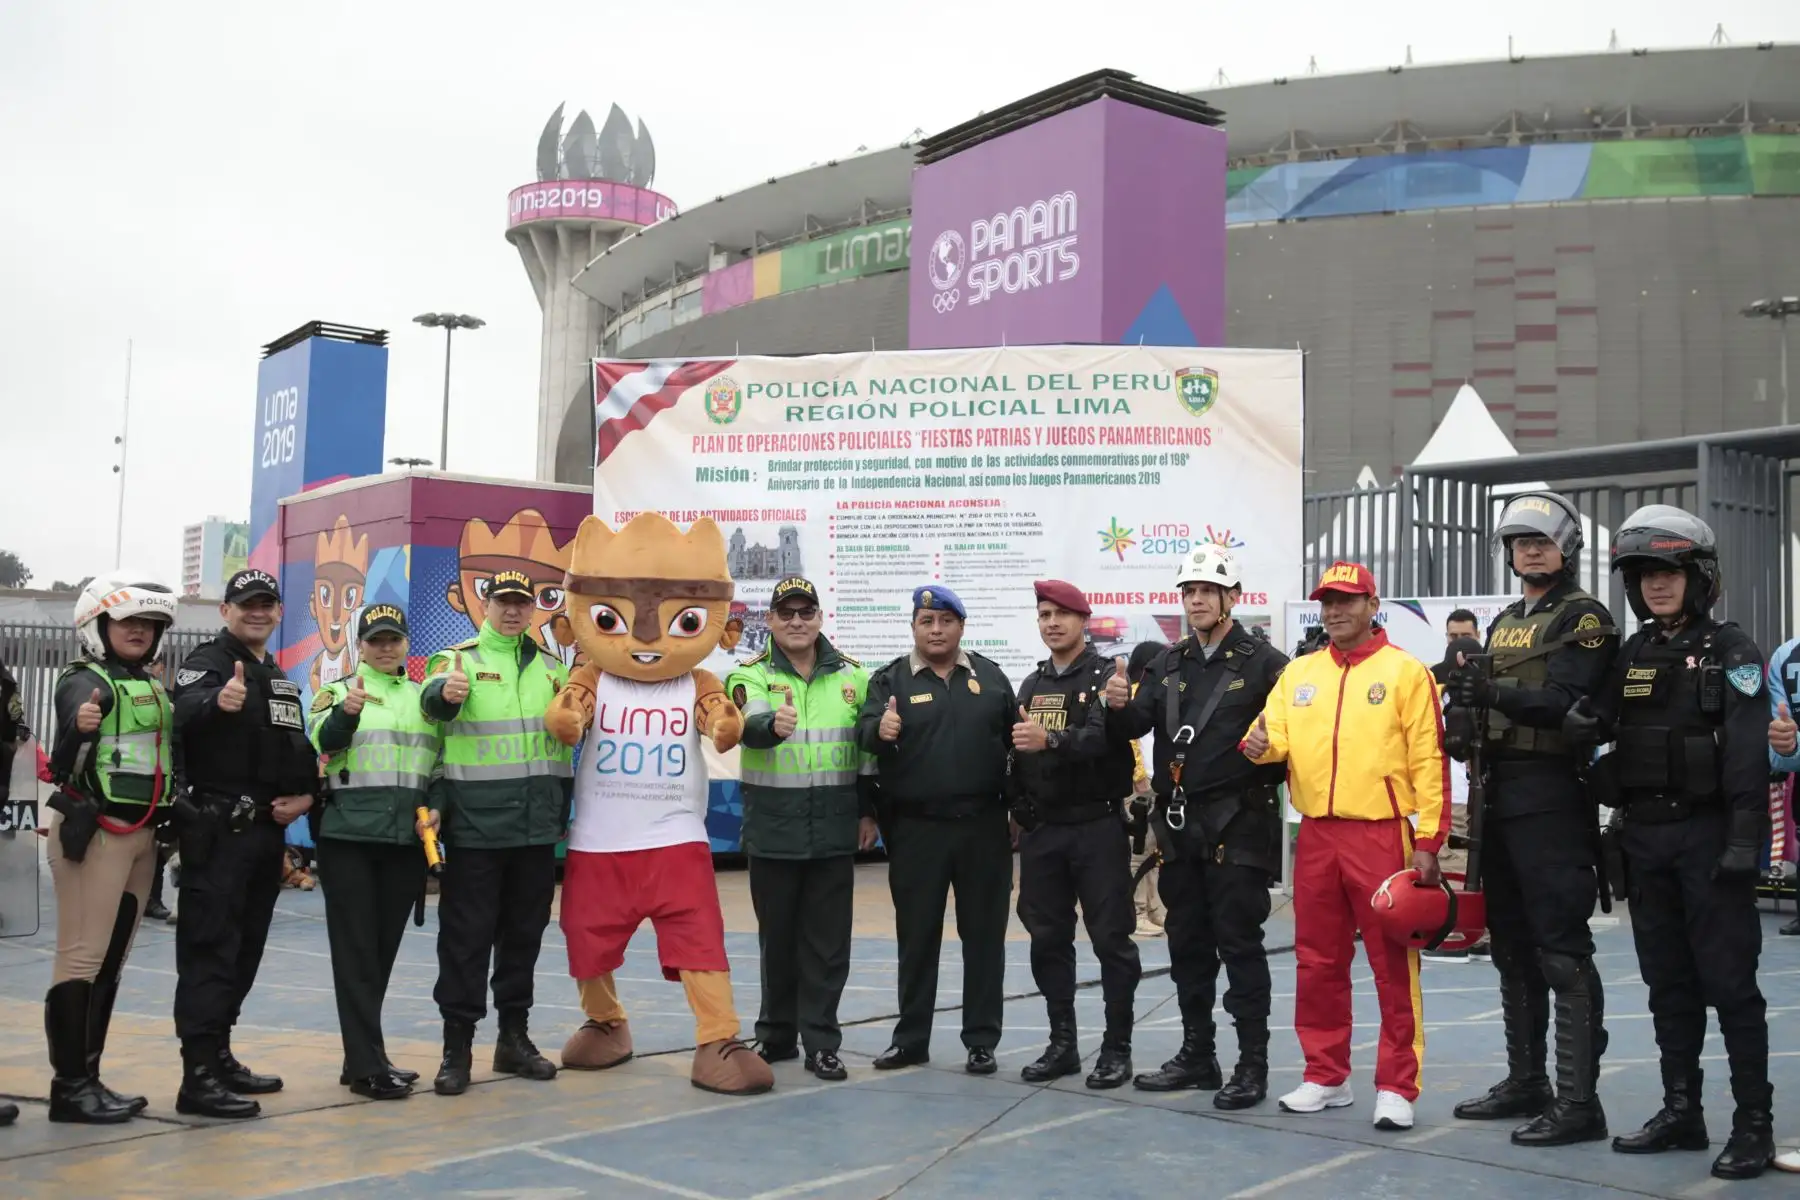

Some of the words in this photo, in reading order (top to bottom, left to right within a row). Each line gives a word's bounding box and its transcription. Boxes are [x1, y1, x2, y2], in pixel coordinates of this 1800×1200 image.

[971, 190, 1078, 261] PANAM
[967, 235, 1080, 306] SPORTS
[747, 375, 858, 399] POLICÍA
[869, 375, 1016, 396] NACIONAL
[1027, 374, 1082, 391] DEL
[1093, 369, 1171, 391] PERÚ
[786, 398, 897, 422] REGIÓN
[910, 398, 1045, 418] POLICIAL
[1056, 398, 1132, 415] LIMA
[262, 424, 296, 468] 2019
[692, 434, 724, 454] PLAN
[728, 434, 744, 453] DE
[747, 432, 835, 453] OPERACIONES
[839, 430, 912, 450] POLICIALES
[977, 427, 1031, 447] PATRIAS
[1035, 427, 1042, 446] Y
[1046, 426, 1095, 446] JUEGOS
[768, 459, 801, 472] Brindar
[804, 458, 853, 473] protección
[855, 461, 860, 472] y
[915, 457, 932, 469] con
[936, 455, 967, 469] motivo
[971, 455, 983, 468] de
[987, 454, 1000, 467] las
[1005, 453, 1059, 467] actividades
[1061, 453, 1140, 467] conmemorativas
[1142, 454, 1157, 467] por
[1159, 453, 1168, 466] el
[768, 477, 820, 491] Aniversario
[824, 477, 835, 490] de
[839, 477, 847, 489] la
[851, 475, 921, 490] Independencia
[969, 473, 983, 487] así
[985, 474, 1010, 486] como
[1013, 473, 1027, 485] los
[1029, 472, 1061, 487] Juegos
[1064, 471, 1137, 486] Panamericanos
[1139, 471, 1161, 485] 2019
[836, 501, 849, 510] LA
[895, 499, 946, 509] NACIONAL
[669, 510, 681, 522] DE
[682, 510, 698, 523] LAS
[762, 509, 807, 522] OFICIALES
[1142, 538, 1190, 554] 2019
[234, 570, 276, 590] POLICIA
[495, 571, 530, 588] POLICIA
[776, 577, 813, 596] POLICIA
[138, 597, 174, 611] POLICIA
[1083, 592, 1145, 605] IDADES
[365, 605, 402, 625] POLICIA
[600, 704, 688, 736] Lima
[597, 739, 686, 777] 2019
